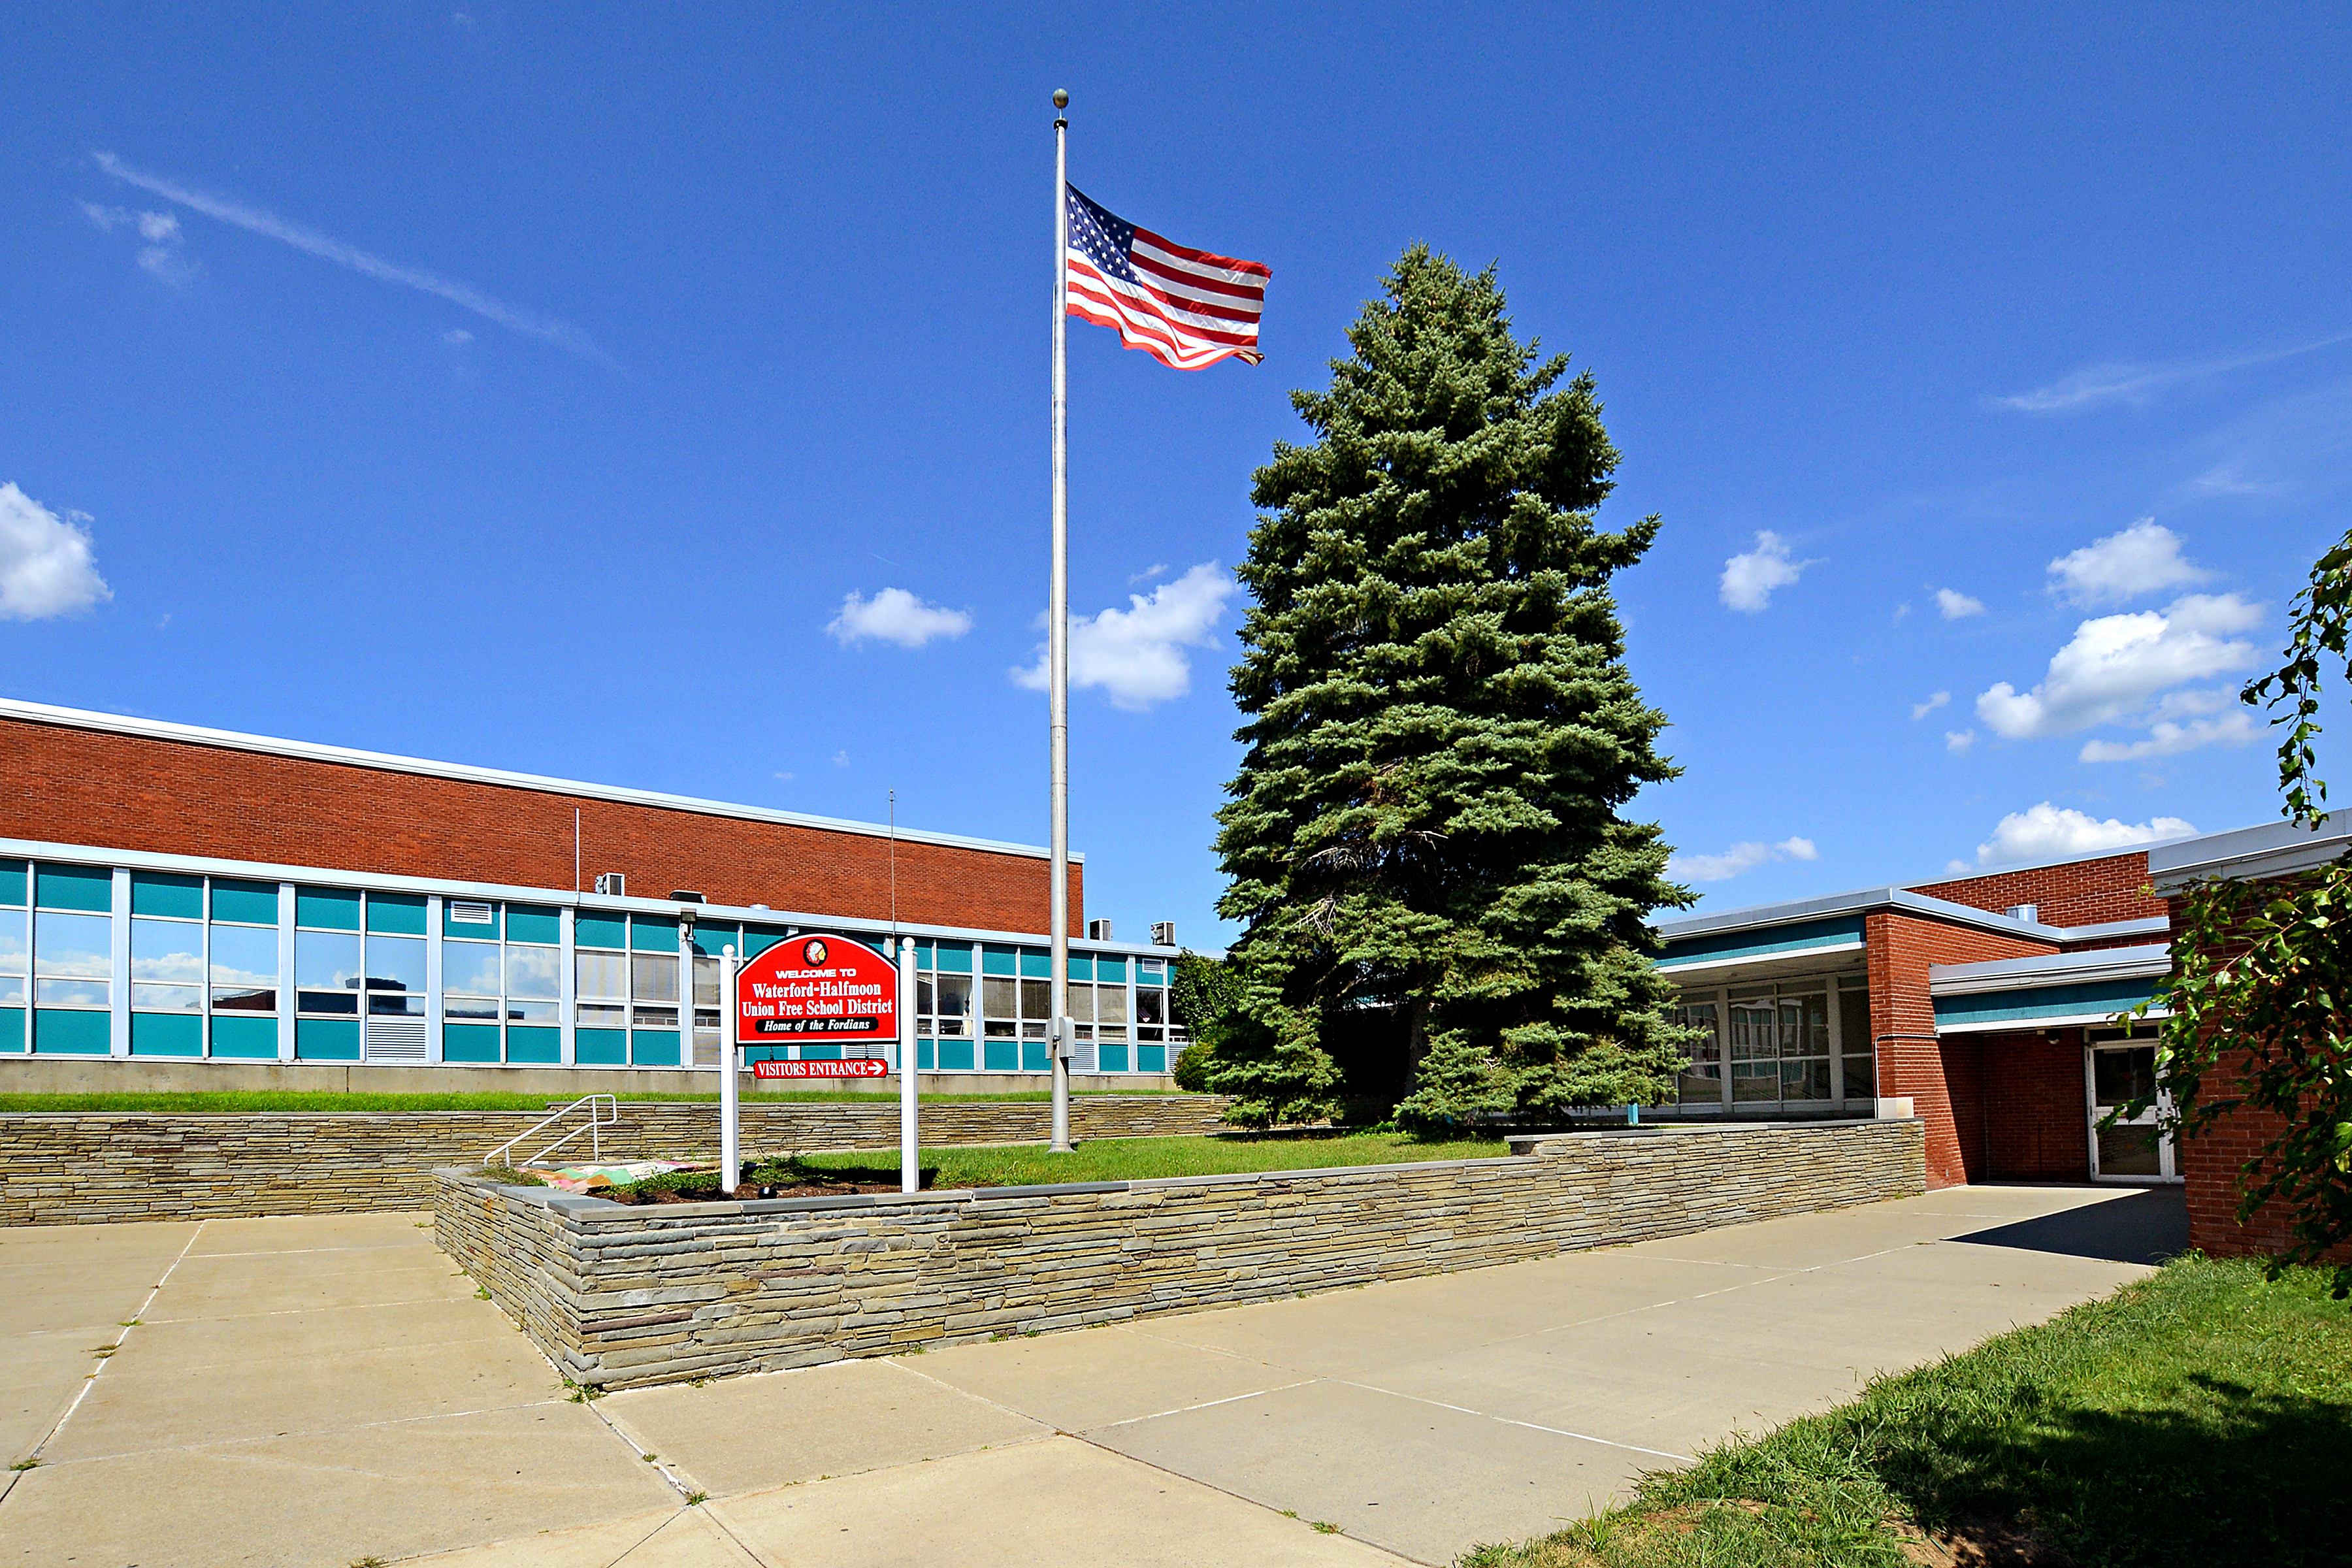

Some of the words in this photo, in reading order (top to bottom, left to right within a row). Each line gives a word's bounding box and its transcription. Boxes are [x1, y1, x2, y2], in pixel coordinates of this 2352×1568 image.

[776, 969, 836, 979] WELCOME
[840, 968, 857, 977] TO
[752, 981, 881, 998] Waterford-Halfmoon
[742, 1001, 775, 1017] Union
[778, 1001, 803, 1016] Free
[806, 1000, 843, 1015] School
[847, 998, 892, 1014] District
[764, 1021, 792, 1032] Home
[794, 1019, 807, 1032] of
[809, 1020, 824, 1030] the
[828, 1019, 870, 1030] Fordians
[758, 1063, 806, 1076] VISITORS
[809, 1062, 868, 1075] ENTRANCE
